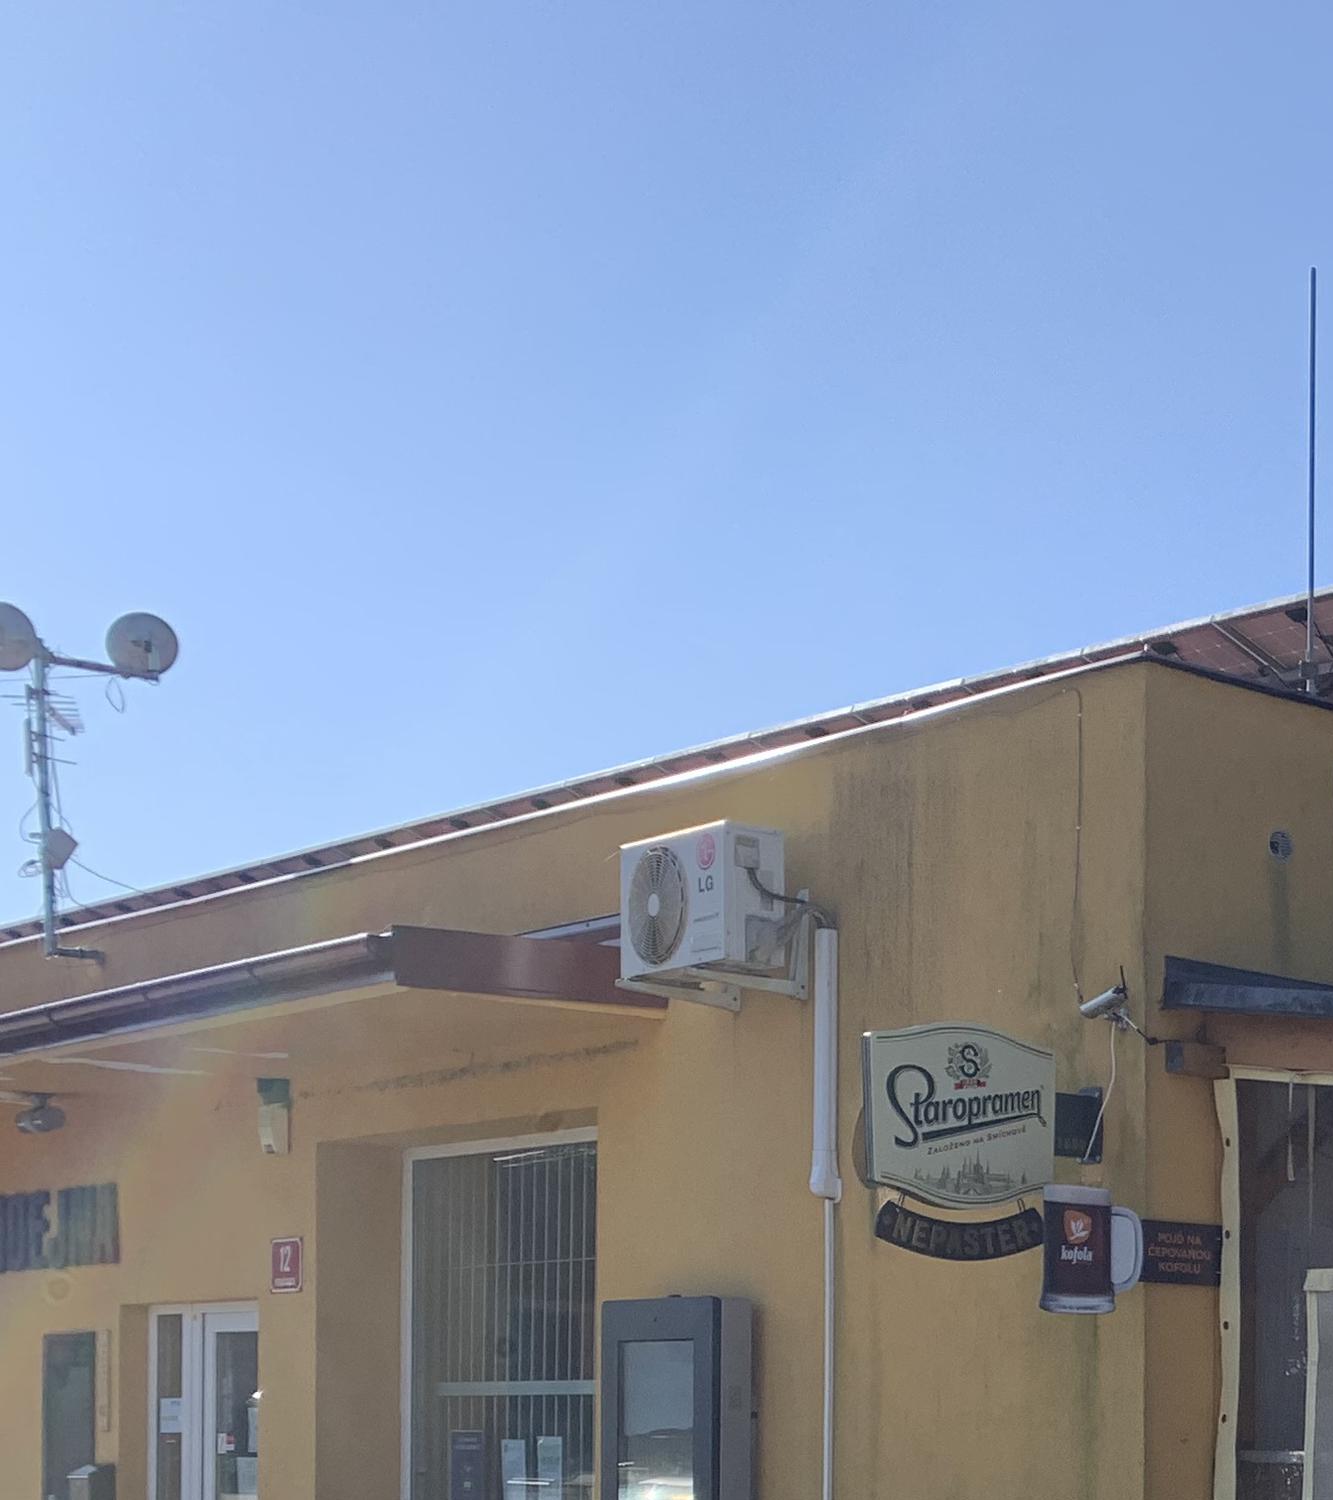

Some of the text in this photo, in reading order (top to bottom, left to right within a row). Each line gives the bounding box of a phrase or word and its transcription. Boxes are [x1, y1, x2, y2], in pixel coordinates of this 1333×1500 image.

[698, 875, 714, 893] LG
[886, 1064, 1045, 1148] Staropramen
[891, 1211, 1035, 1256] NEPASTER
[1186, 1233, 1203, 1246] NA
[279, 1245, 291, 1272] 12
[1060, 1245, 1093, 1265] kofola
[1158, 1261, 1202, 1275] KOFOLU
